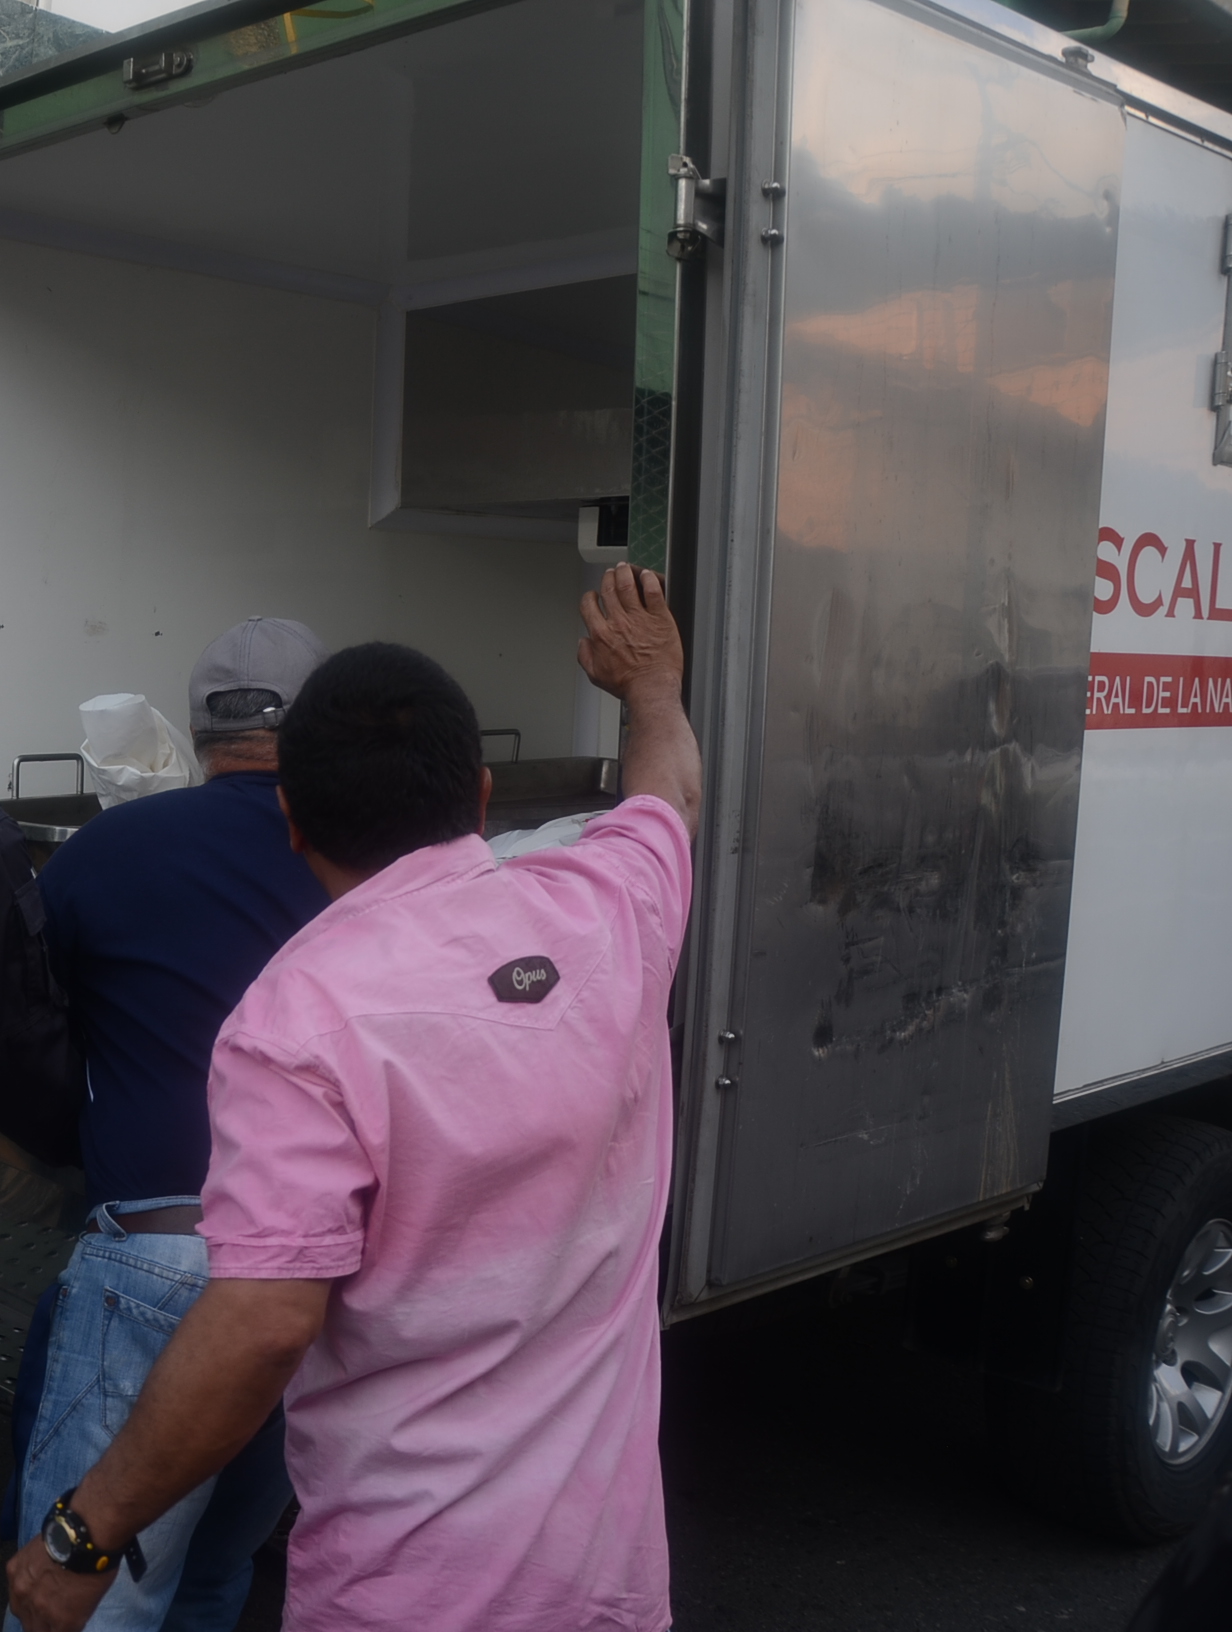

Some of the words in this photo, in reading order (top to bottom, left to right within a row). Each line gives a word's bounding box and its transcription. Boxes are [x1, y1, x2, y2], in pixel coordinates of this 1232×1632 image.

[1142, 676, 1173, 714] DE
[1177, 676, 1202, 714] LA
[511, 966, 548, 991] Opus
